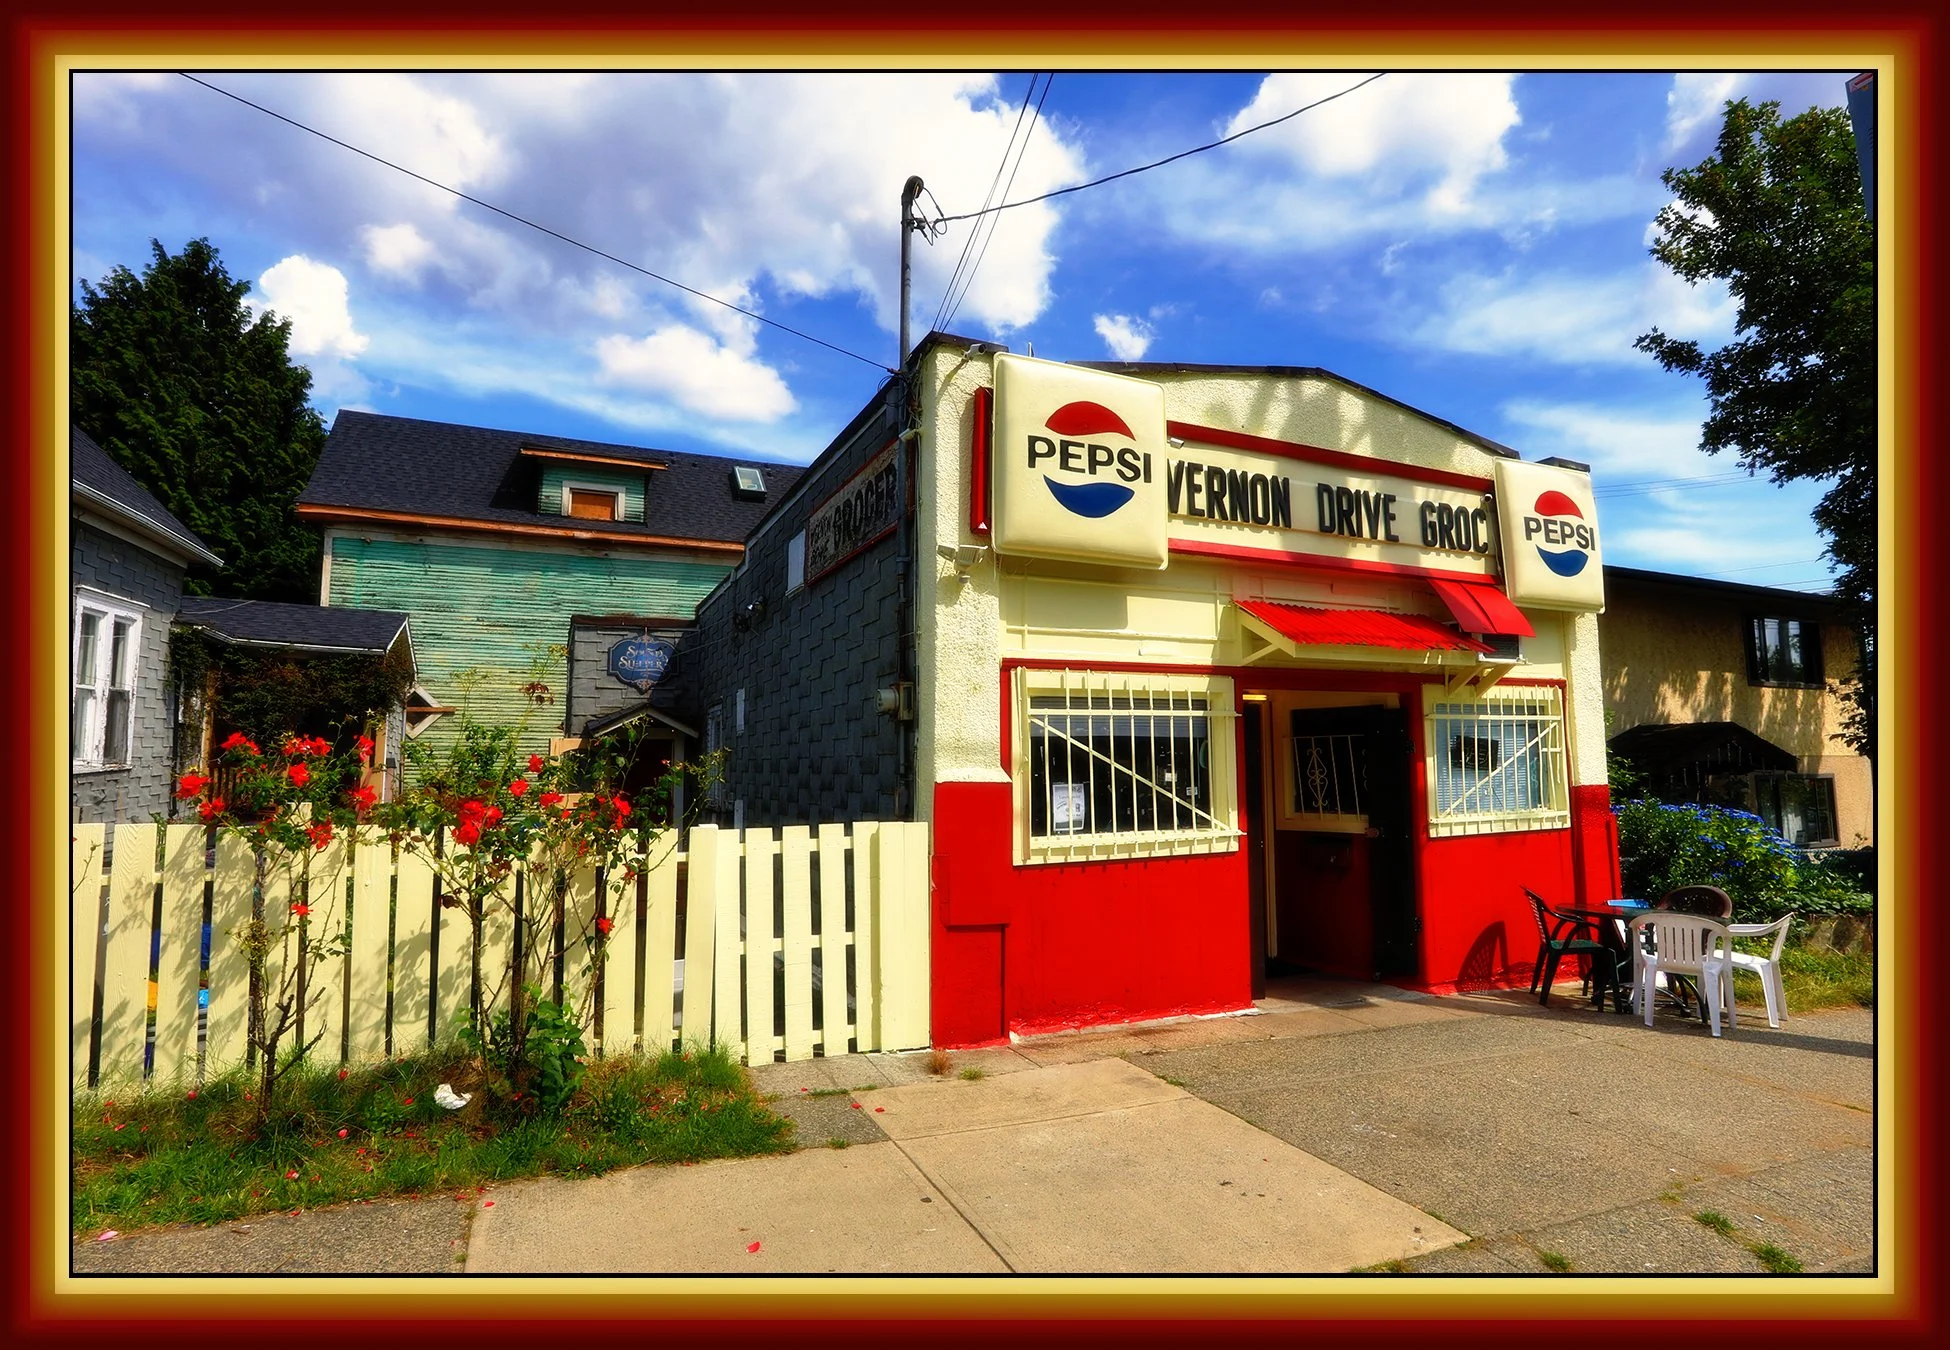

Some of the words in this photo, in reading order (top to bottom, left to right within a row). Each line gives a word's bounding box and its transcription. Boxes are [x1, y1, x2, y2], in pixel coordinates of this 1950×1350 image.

[1028, 435, 1152, 483] PEPSI
[1167, 458, 1292, 529] VERNON
[1317, 483, 1399, 542] DRIVE
[1420, 500, 1489, 554] GROC
[1523, 516, 1596, 551] PEPSI
